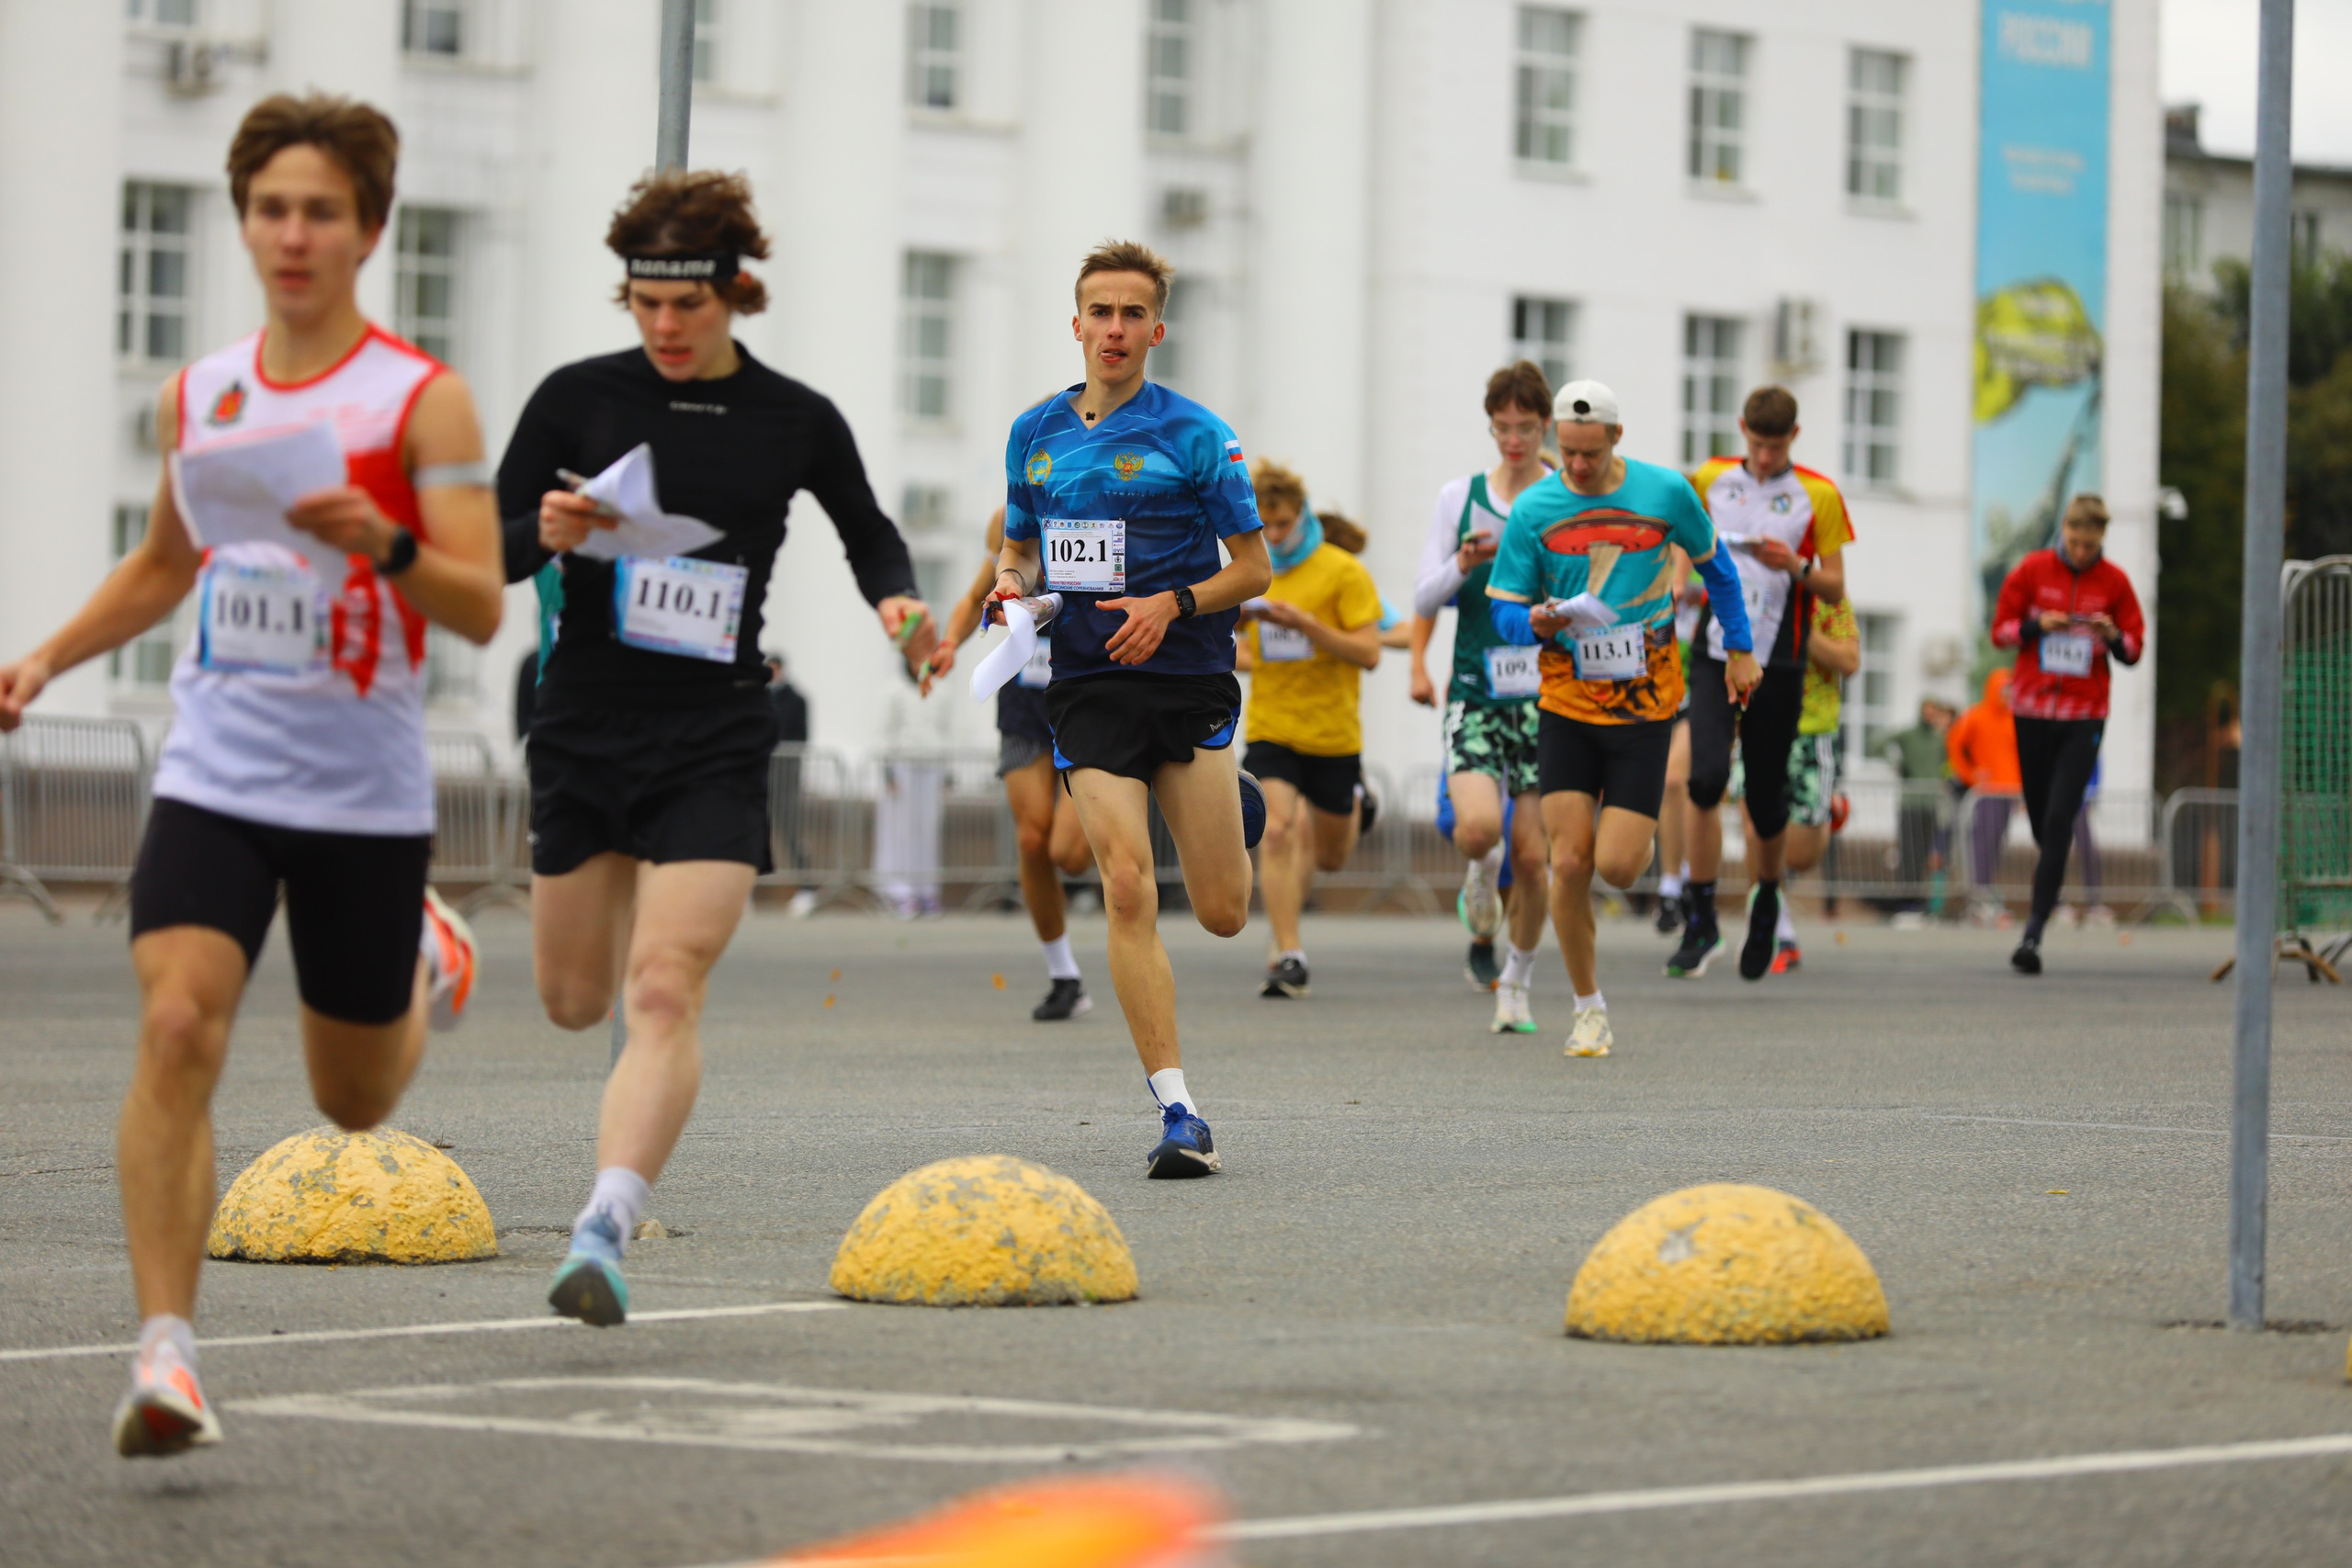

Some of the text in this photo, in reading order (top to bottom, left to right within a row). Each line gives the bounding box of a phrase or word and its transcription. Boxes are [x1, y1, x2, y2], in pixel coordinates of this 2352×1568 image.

[1049, 538, 1108, 563] 102.1
[217, 591, 303, 635] 101.1
[638, 578, 720, 620] 110.1
[1584, 639, 1631, 660] 113.1
